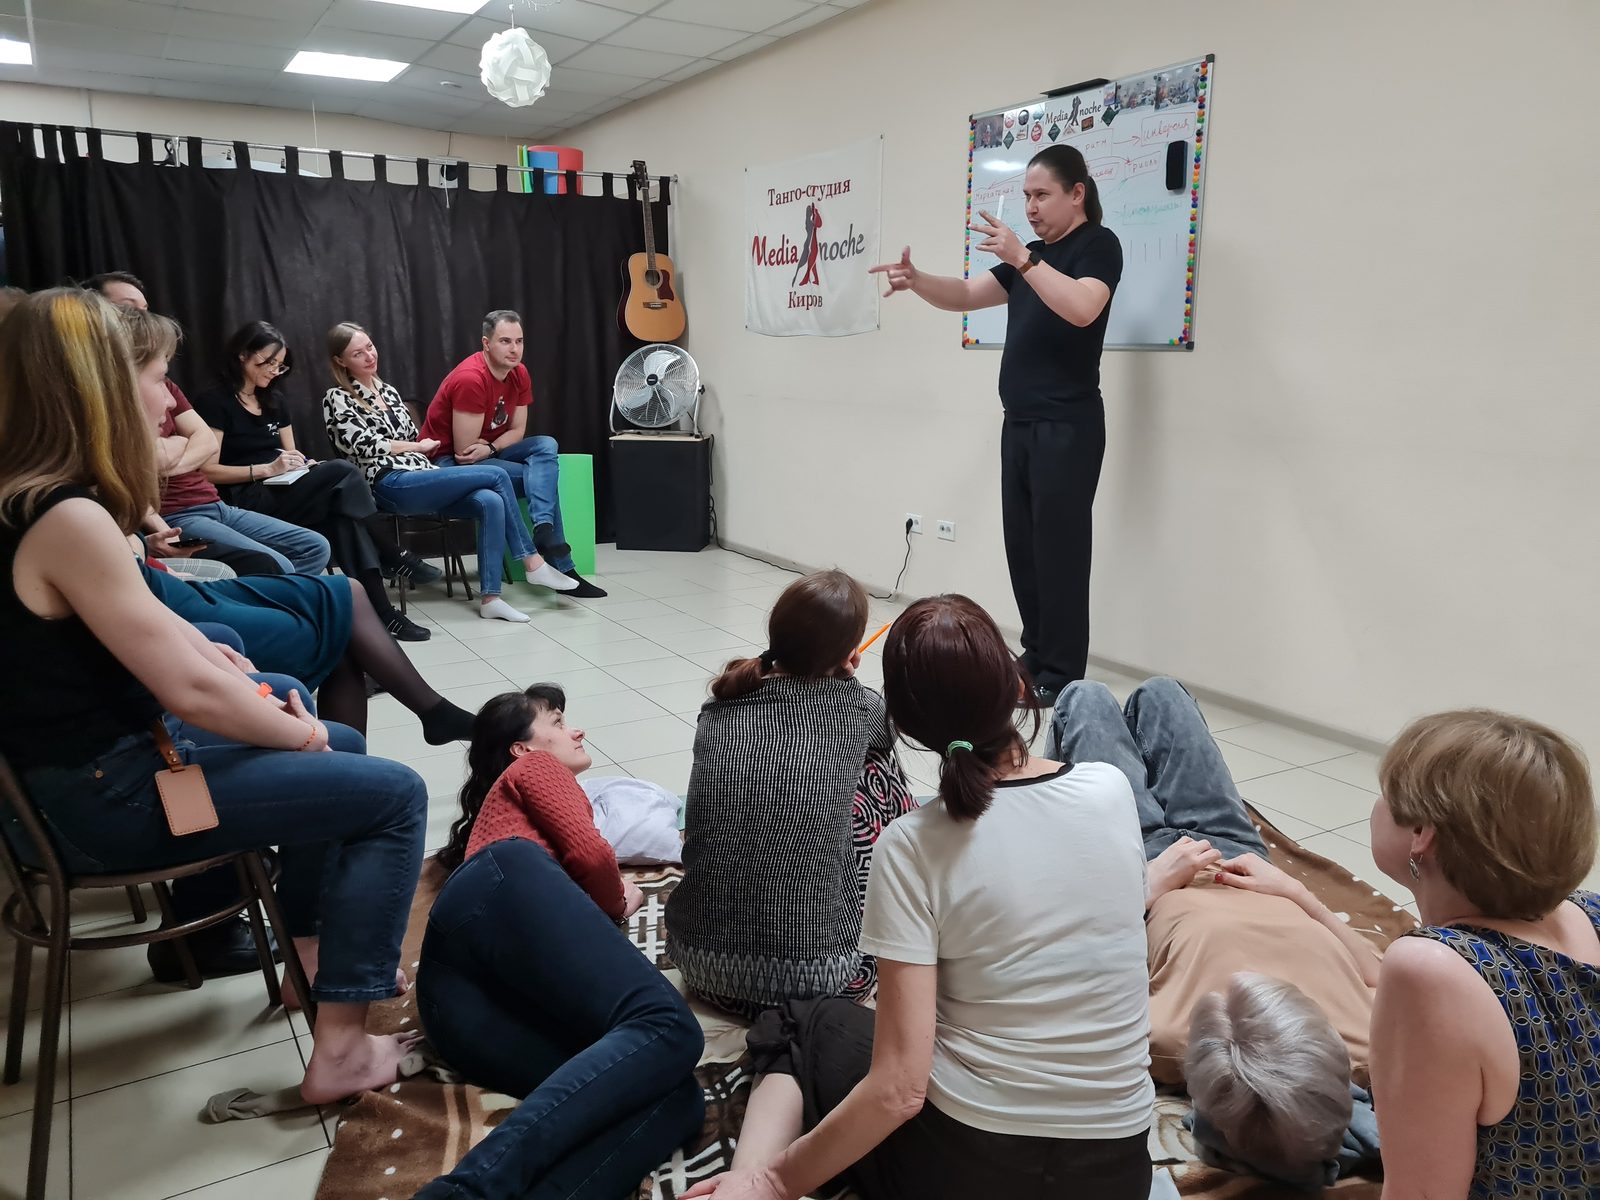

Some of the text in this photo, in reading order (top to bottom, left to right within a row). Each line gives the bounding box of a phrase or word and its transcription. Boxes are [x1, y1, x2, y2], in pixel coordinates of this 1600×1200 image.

[1045, 109, 1068, 125] Media
[1079, 102, 1101, 116] noche
[767, 179, 851, 206] Танго-студия
[752, 223, 865, 266] Media noche
[788, 291, 823, 310] Киров
